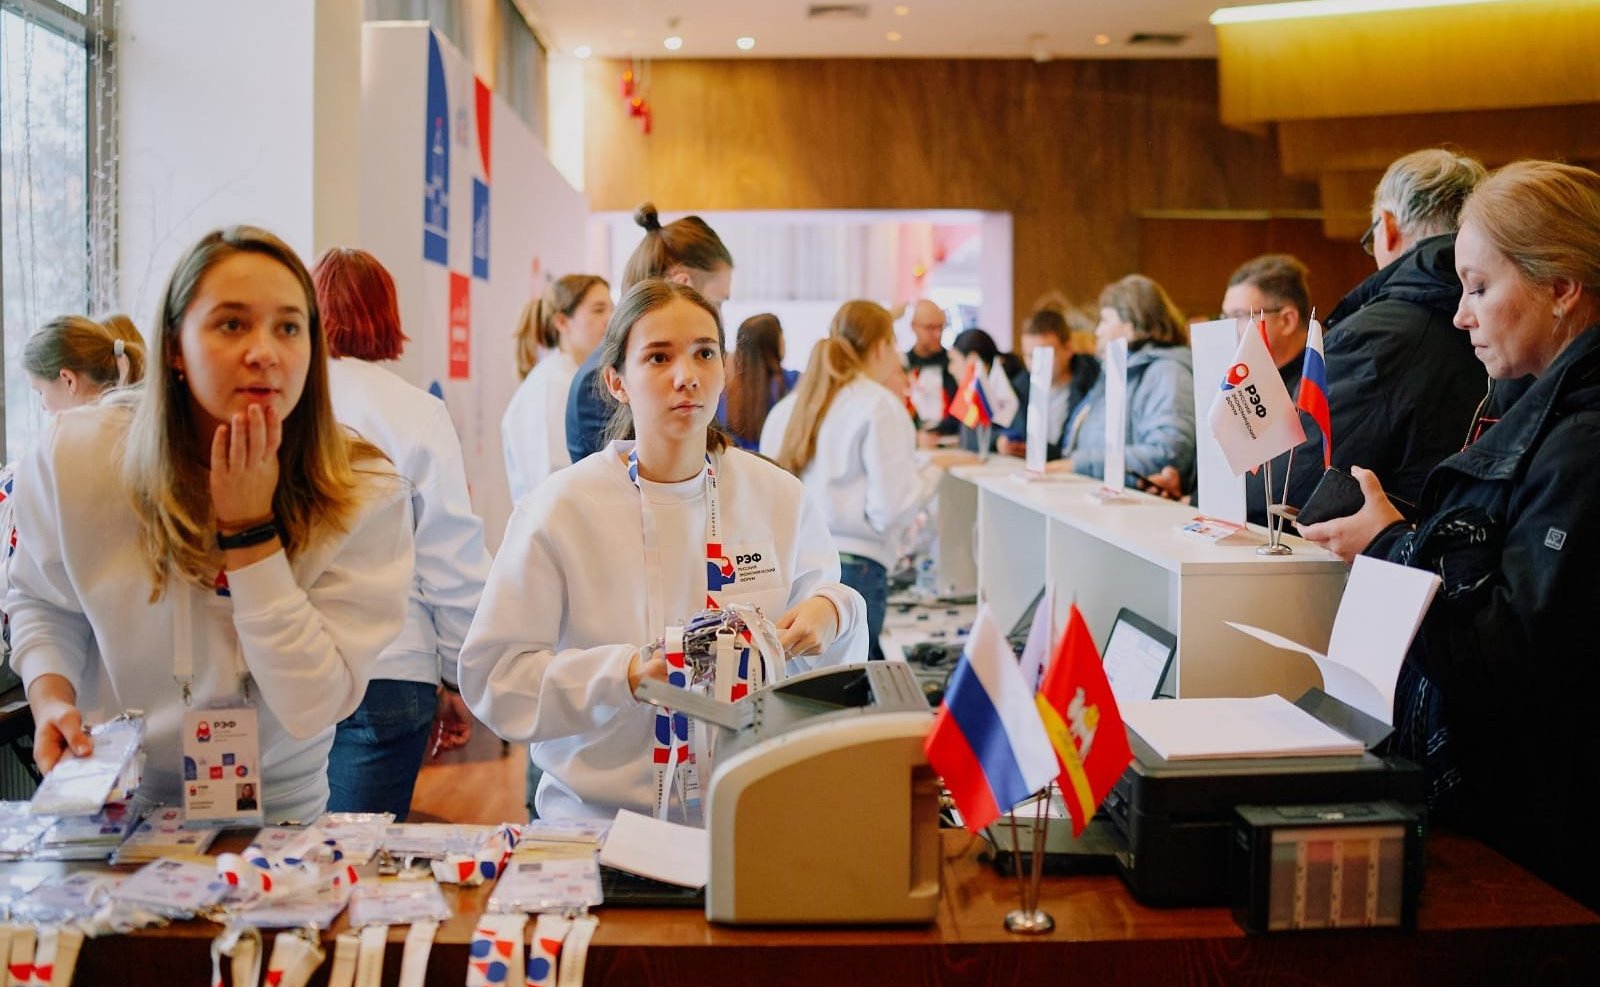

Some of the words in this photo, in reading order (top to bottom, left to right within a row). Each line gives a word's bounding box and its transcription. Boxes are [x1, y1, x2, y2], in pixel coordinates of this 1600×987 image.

[1225, 396, 1238, 416] ФОРУМ
[1237, 390, 1252, 415] РУССКИЙ
[1245, 384, 1267, 418] РЭФ
[1231, 393, 1257, 440] ЭКОНОМИЧЕСКИЙ
[735, 552, 762, 565] РЭФ
[213, 720, 236, 729] РЭФ
